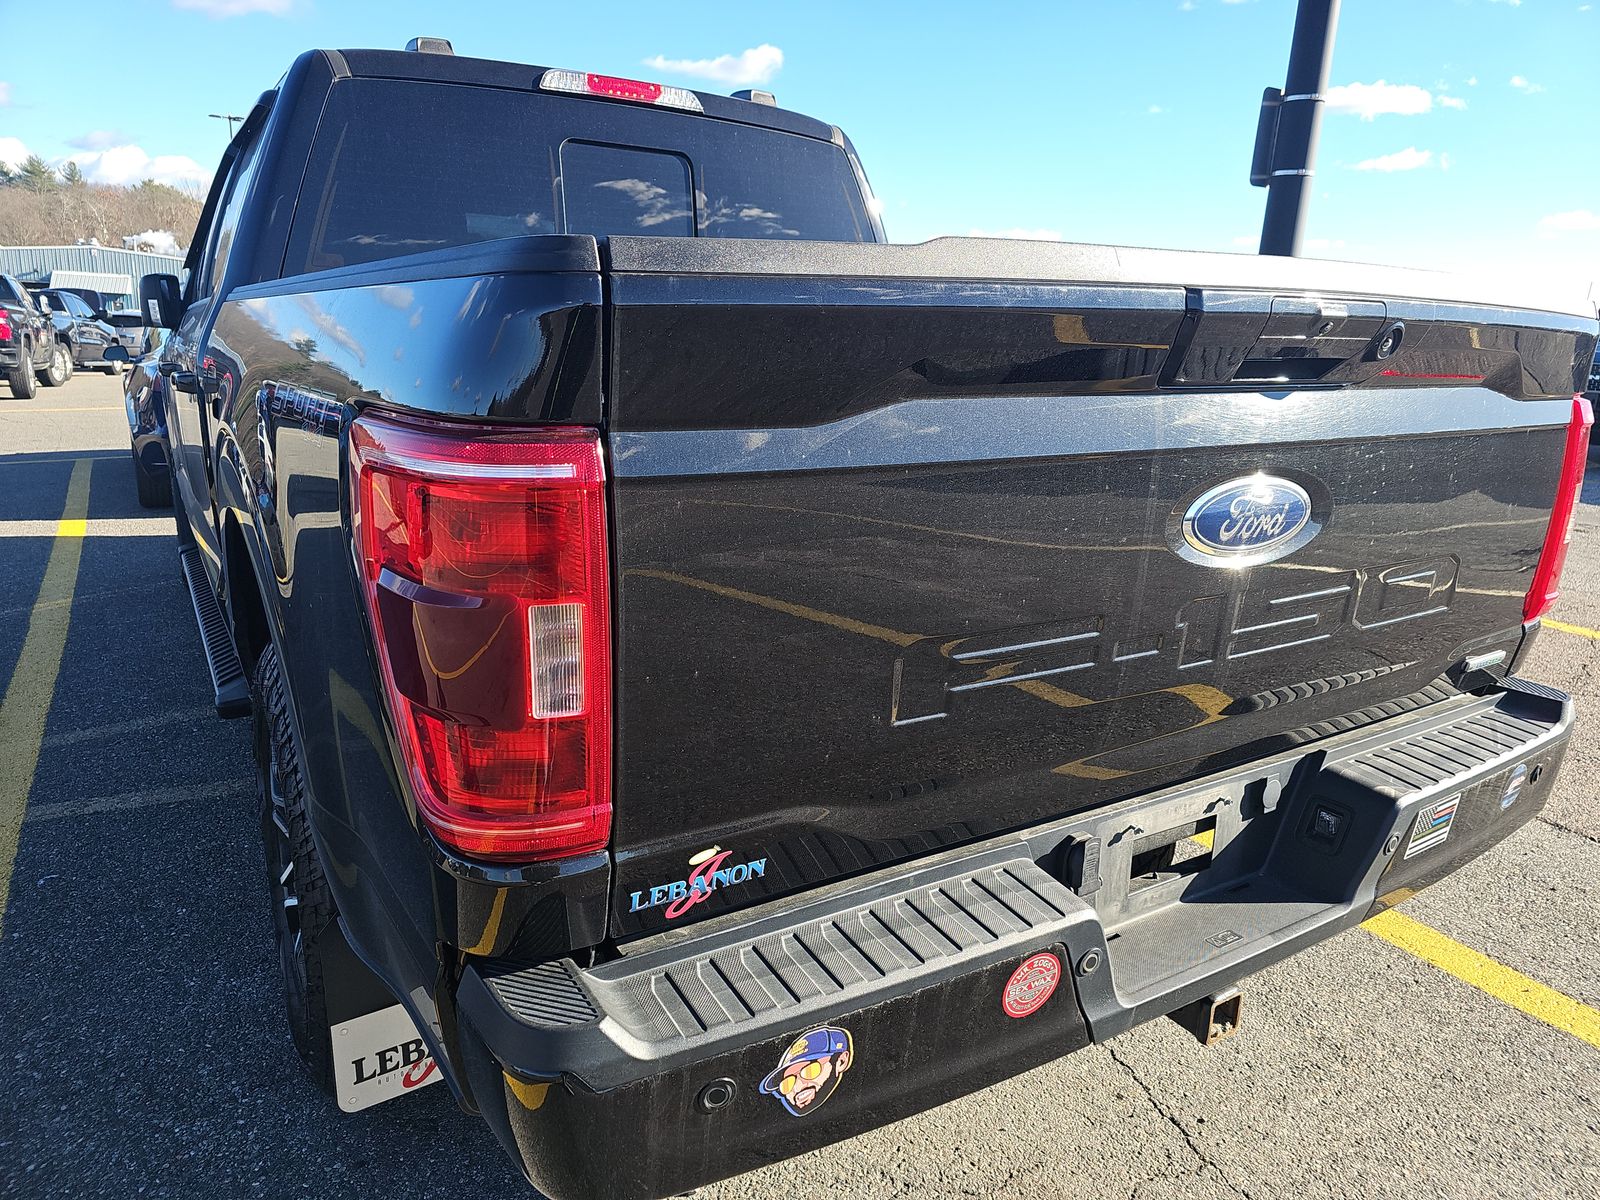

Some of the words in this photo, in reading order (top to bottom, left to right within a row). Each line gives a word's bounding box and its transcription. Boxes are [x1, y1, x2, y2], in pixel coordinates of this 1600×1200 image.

[270, 380, 338, 428] SPORT
[1219, 489, 1290, 541] Ford
[890, 553, 1462, 728] F-150
[628, 858, 767, 913] LEBANON
[1009, 983, 1029, 996] SEX
[1030, 974, 1053, 988] WAX
[351, 1038, 431, 1086] LEB
